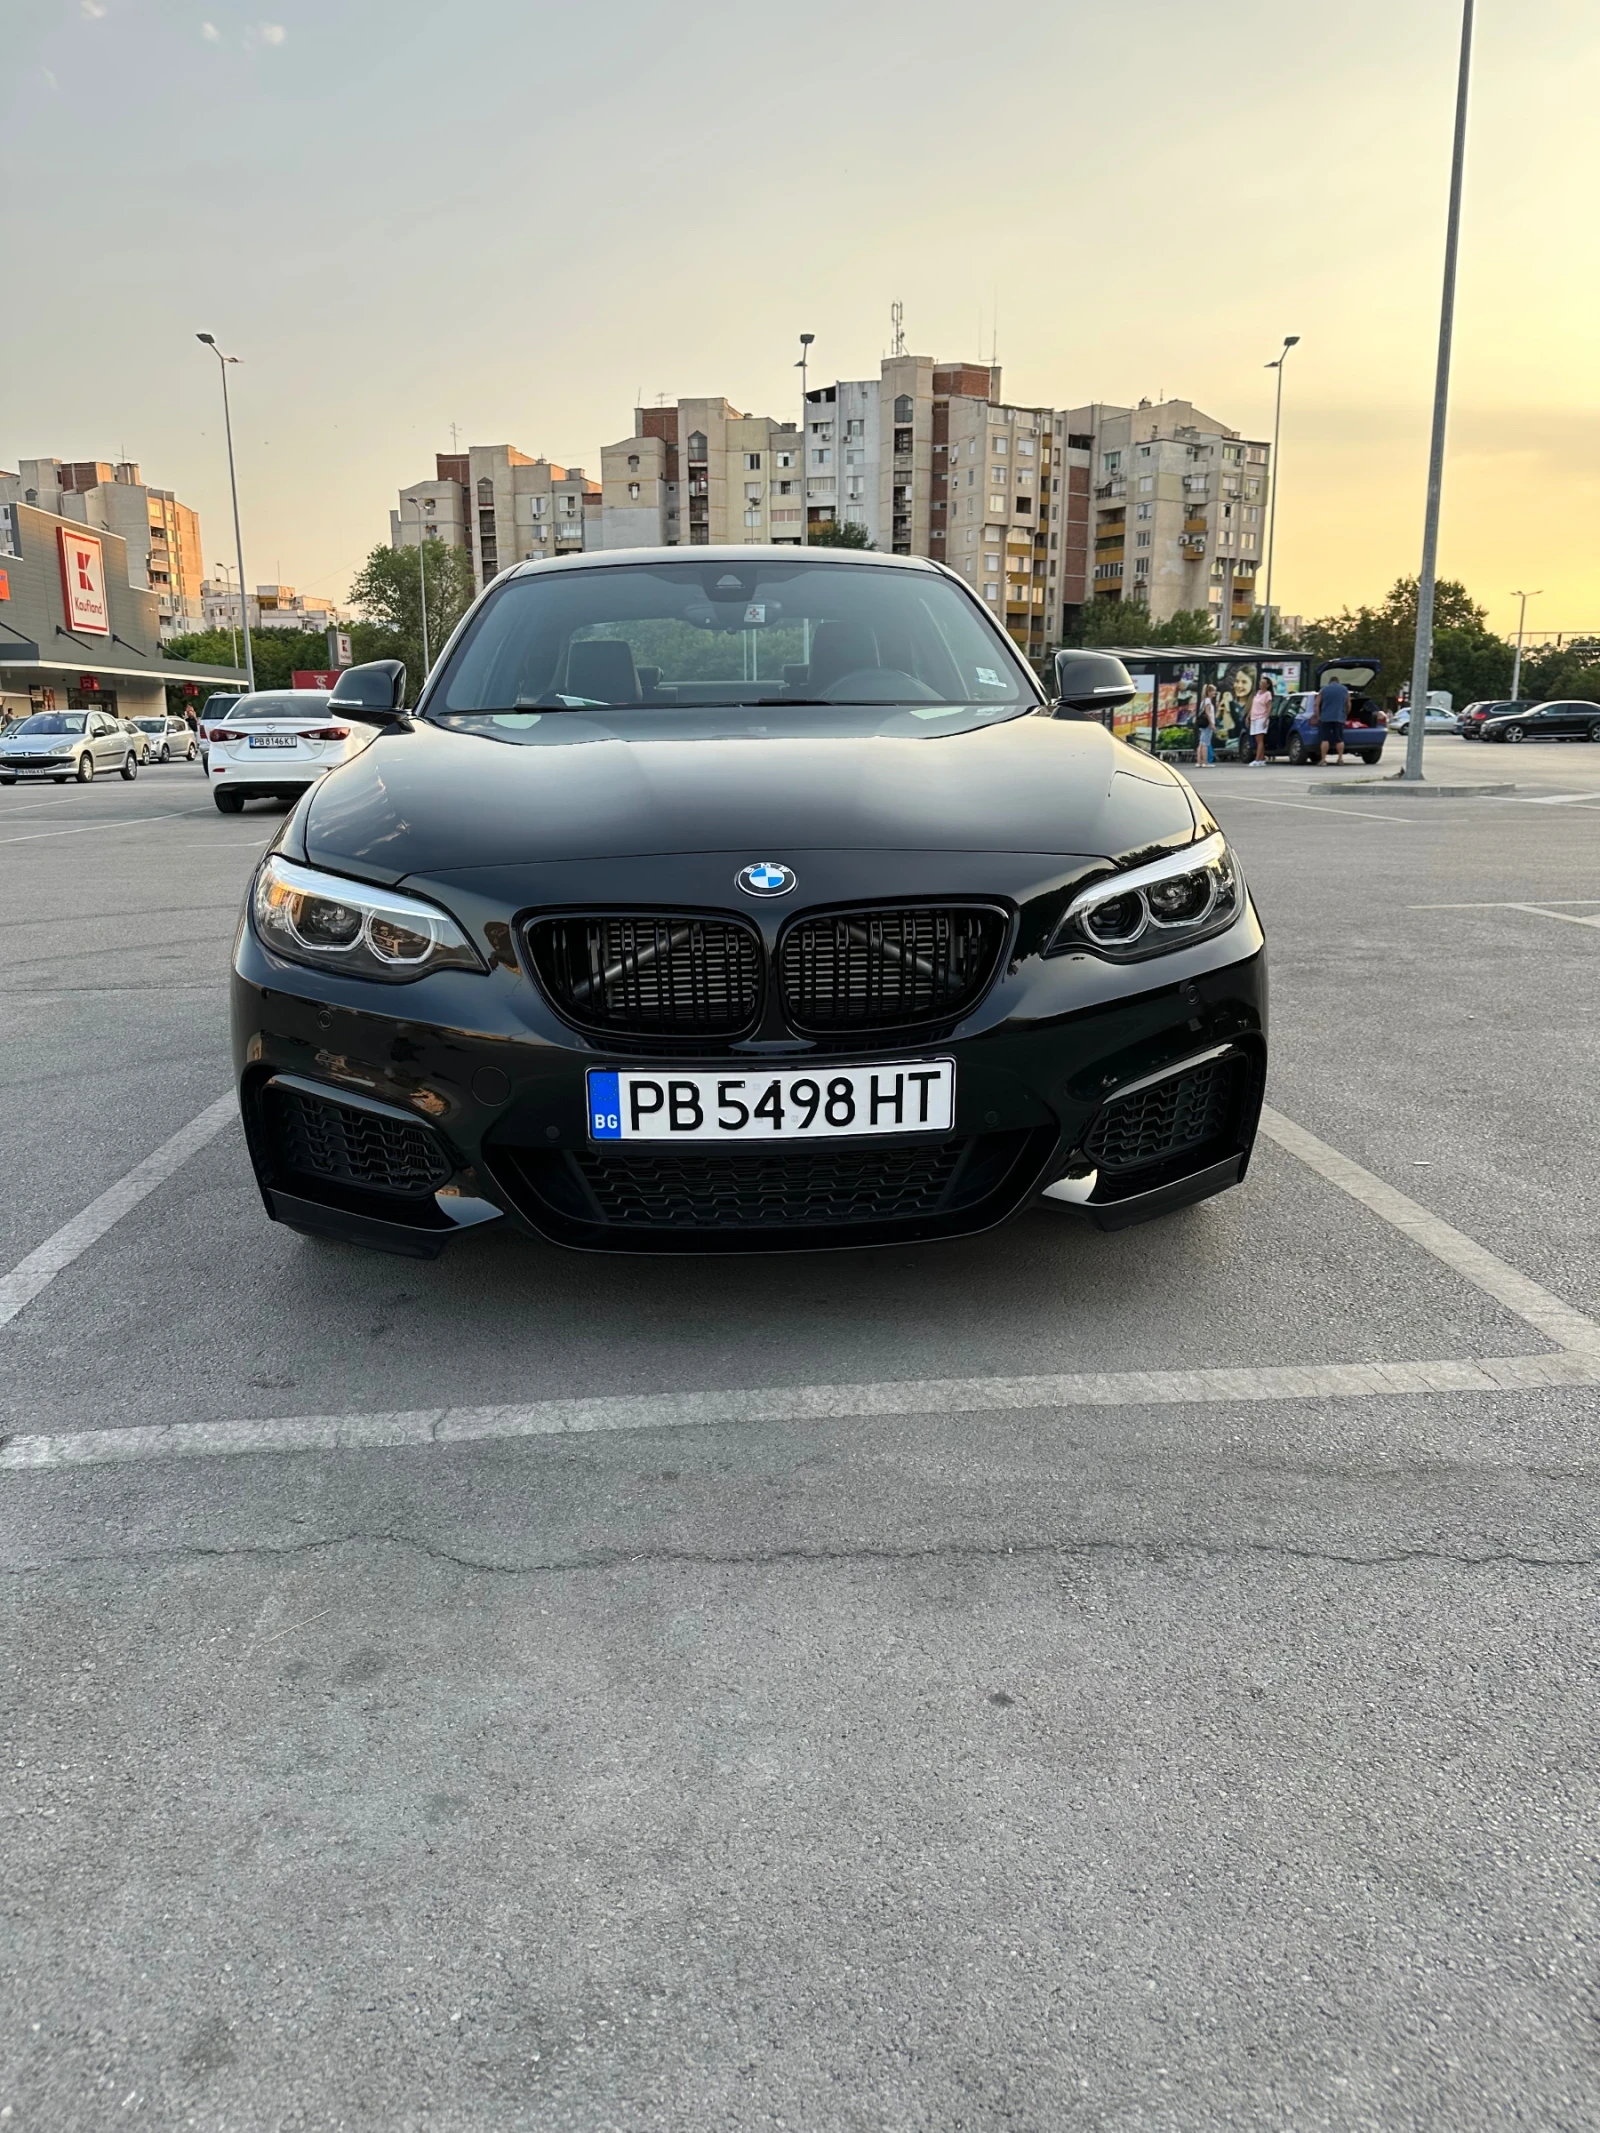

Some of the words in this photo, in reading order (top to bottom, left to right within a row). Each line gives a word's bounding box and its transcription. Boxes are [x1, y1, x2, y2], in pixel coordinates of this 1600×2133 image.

[77, 551, 94, 591] K
[75, 597, 102, 615] Kaufland
[743, 862, 791, 873] BMW
[595, 1114, 618, 1129] BG
